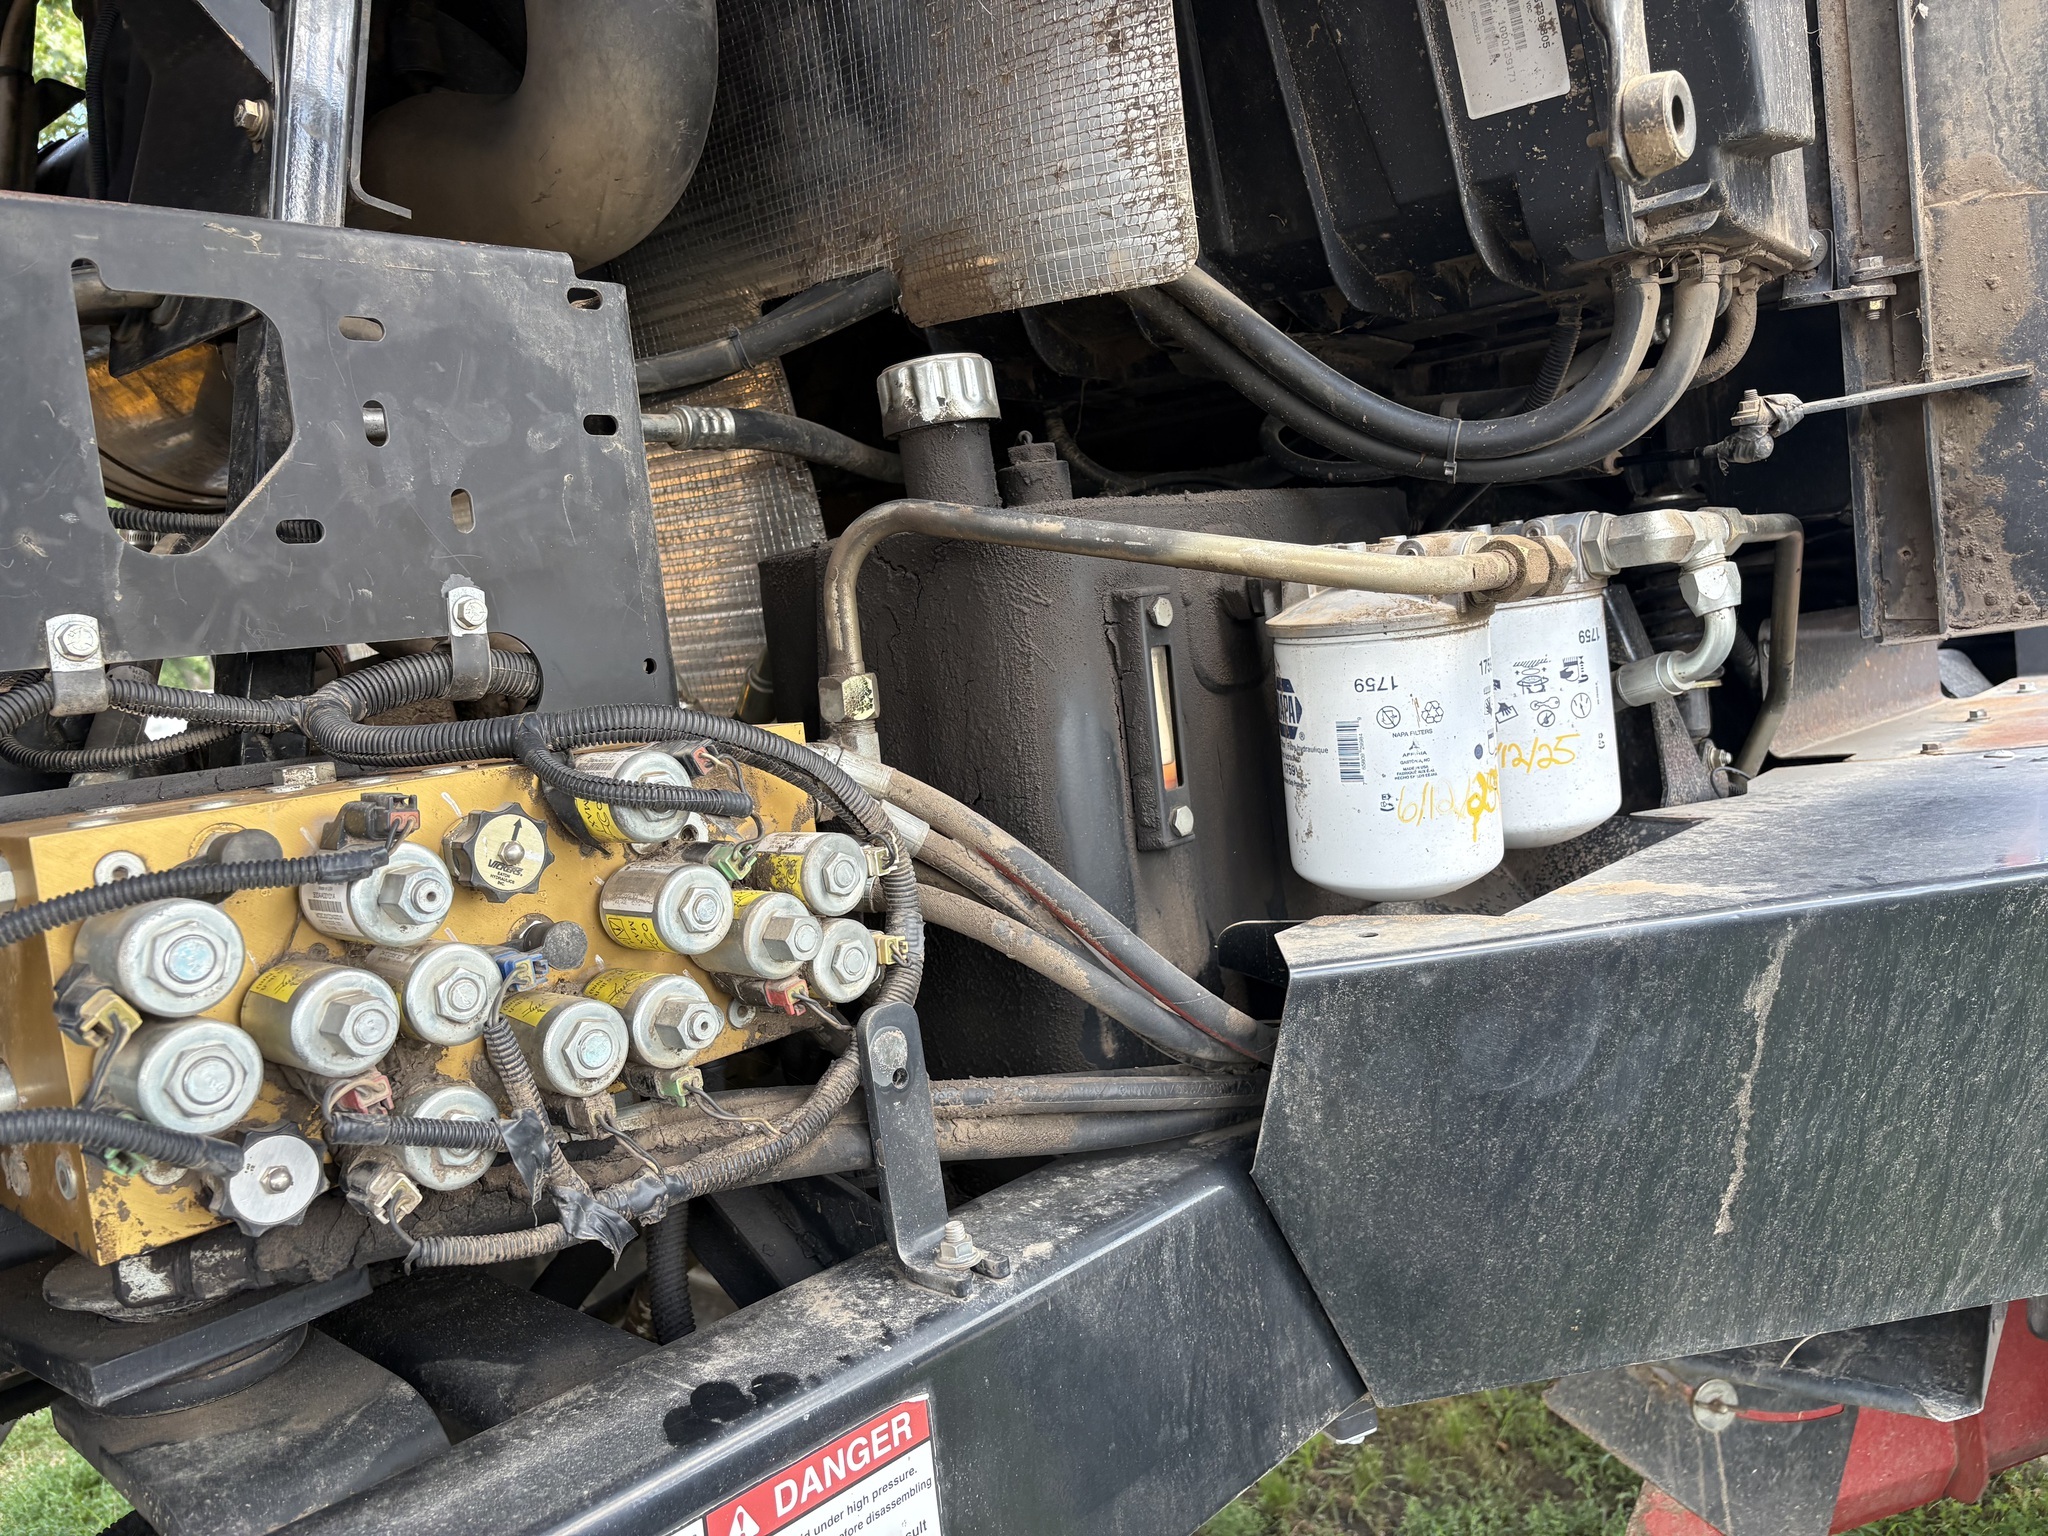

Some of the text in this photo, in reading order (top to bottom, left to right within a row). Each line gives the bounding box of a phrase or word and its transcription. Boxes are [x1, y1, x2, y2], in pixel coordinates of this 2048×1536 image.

[1578, 626, 1600, 644] 1759
[1354, 675, 1398, 693] 1759
[1409, 728, 1433, 736] FILTERS
[774, 1411, 913, 1518] DANGER
[814, 1467, 917, 1536] under high pressure.
[865, 1477, 932, 1525] disassembling
